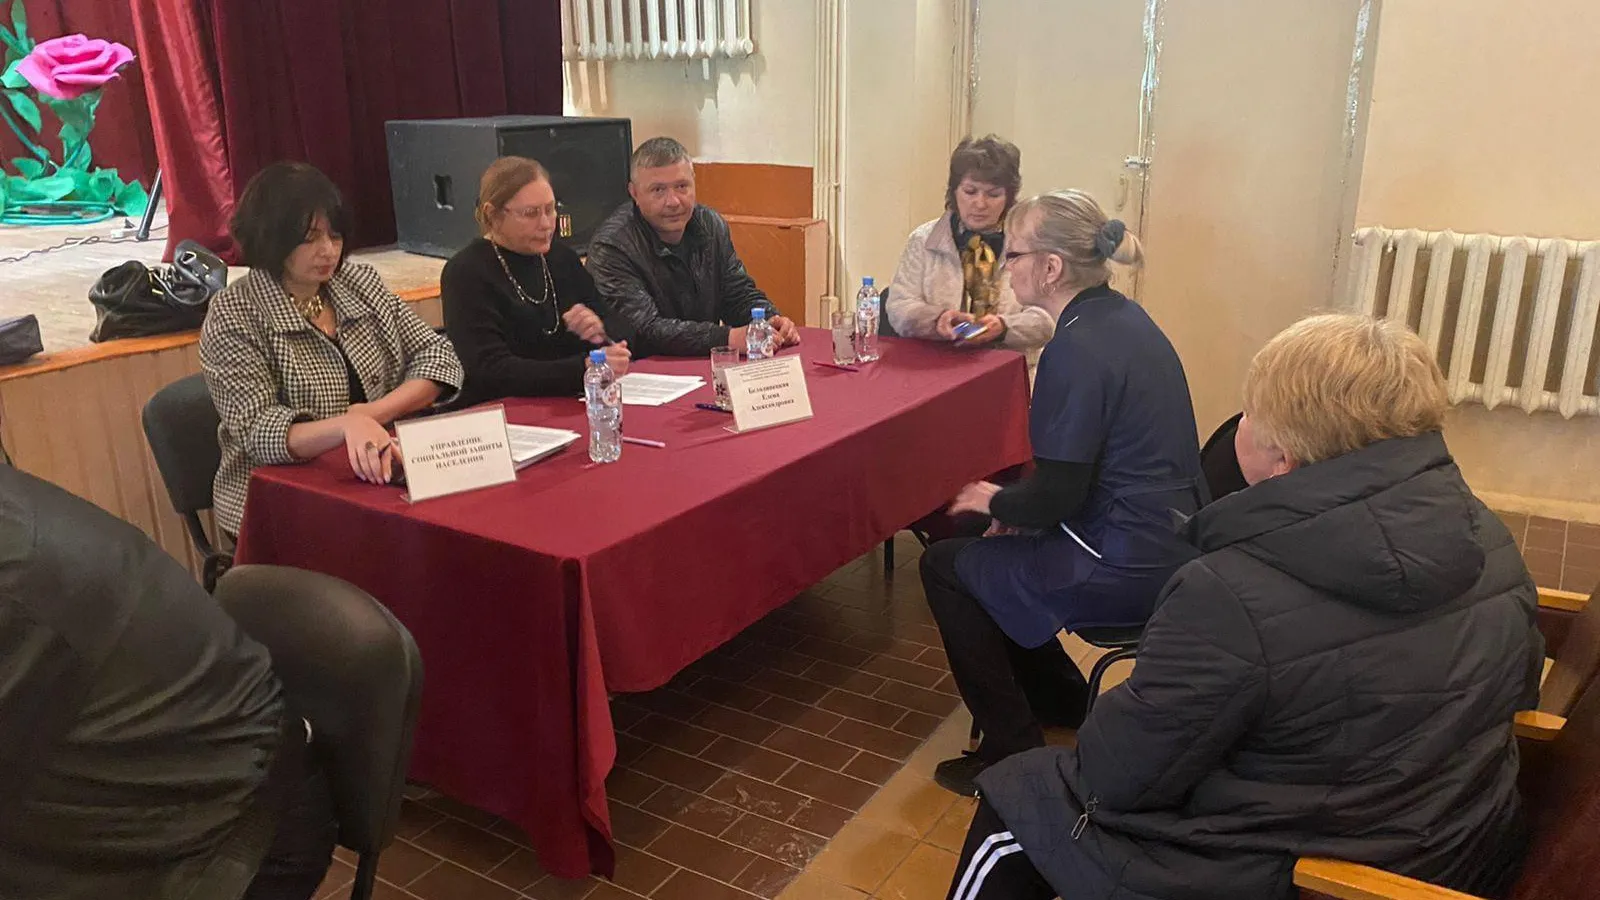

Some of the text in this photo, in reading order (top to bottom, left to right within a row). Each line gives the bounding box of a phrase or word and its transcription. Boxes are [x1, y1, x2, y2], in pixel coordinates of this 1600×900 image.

[430, 436, 483, 451] УПРАВЛЕНИЕ
[411, 448, 468, 464] СОЦИАЛЬНОЙ
[470, 442, 504, 454] ЗАЩИТЫ
[435, 455, 484, 470] НАСЕЛЕНИЯ
